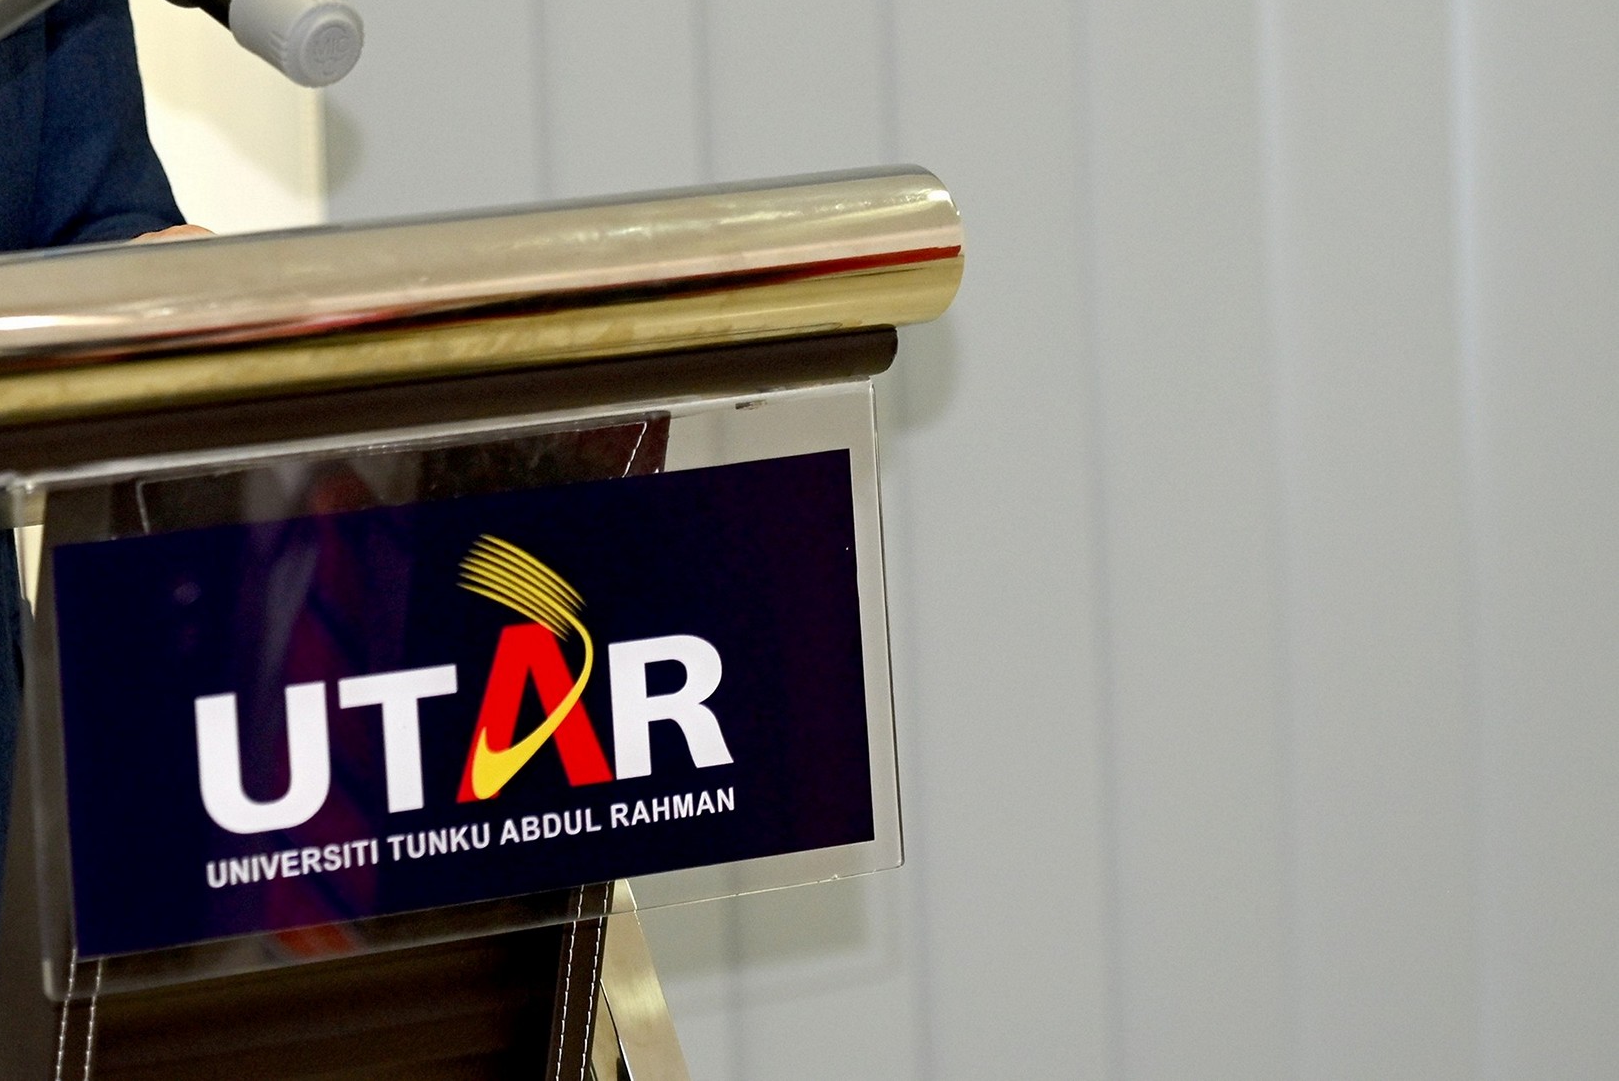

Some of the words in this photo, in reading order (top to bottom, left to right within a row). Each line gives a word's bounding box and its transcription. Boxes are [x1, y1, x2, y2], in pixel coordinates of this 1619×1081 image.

[194, 623, 734, 834] UTAR
[206, 839, 379, 888] UNIVERSITI
[387, 829, 490, 861] TUNKU
[500, 808, 602, 846] ABDUL
[610, 786, 735, 829] RAHMAN
